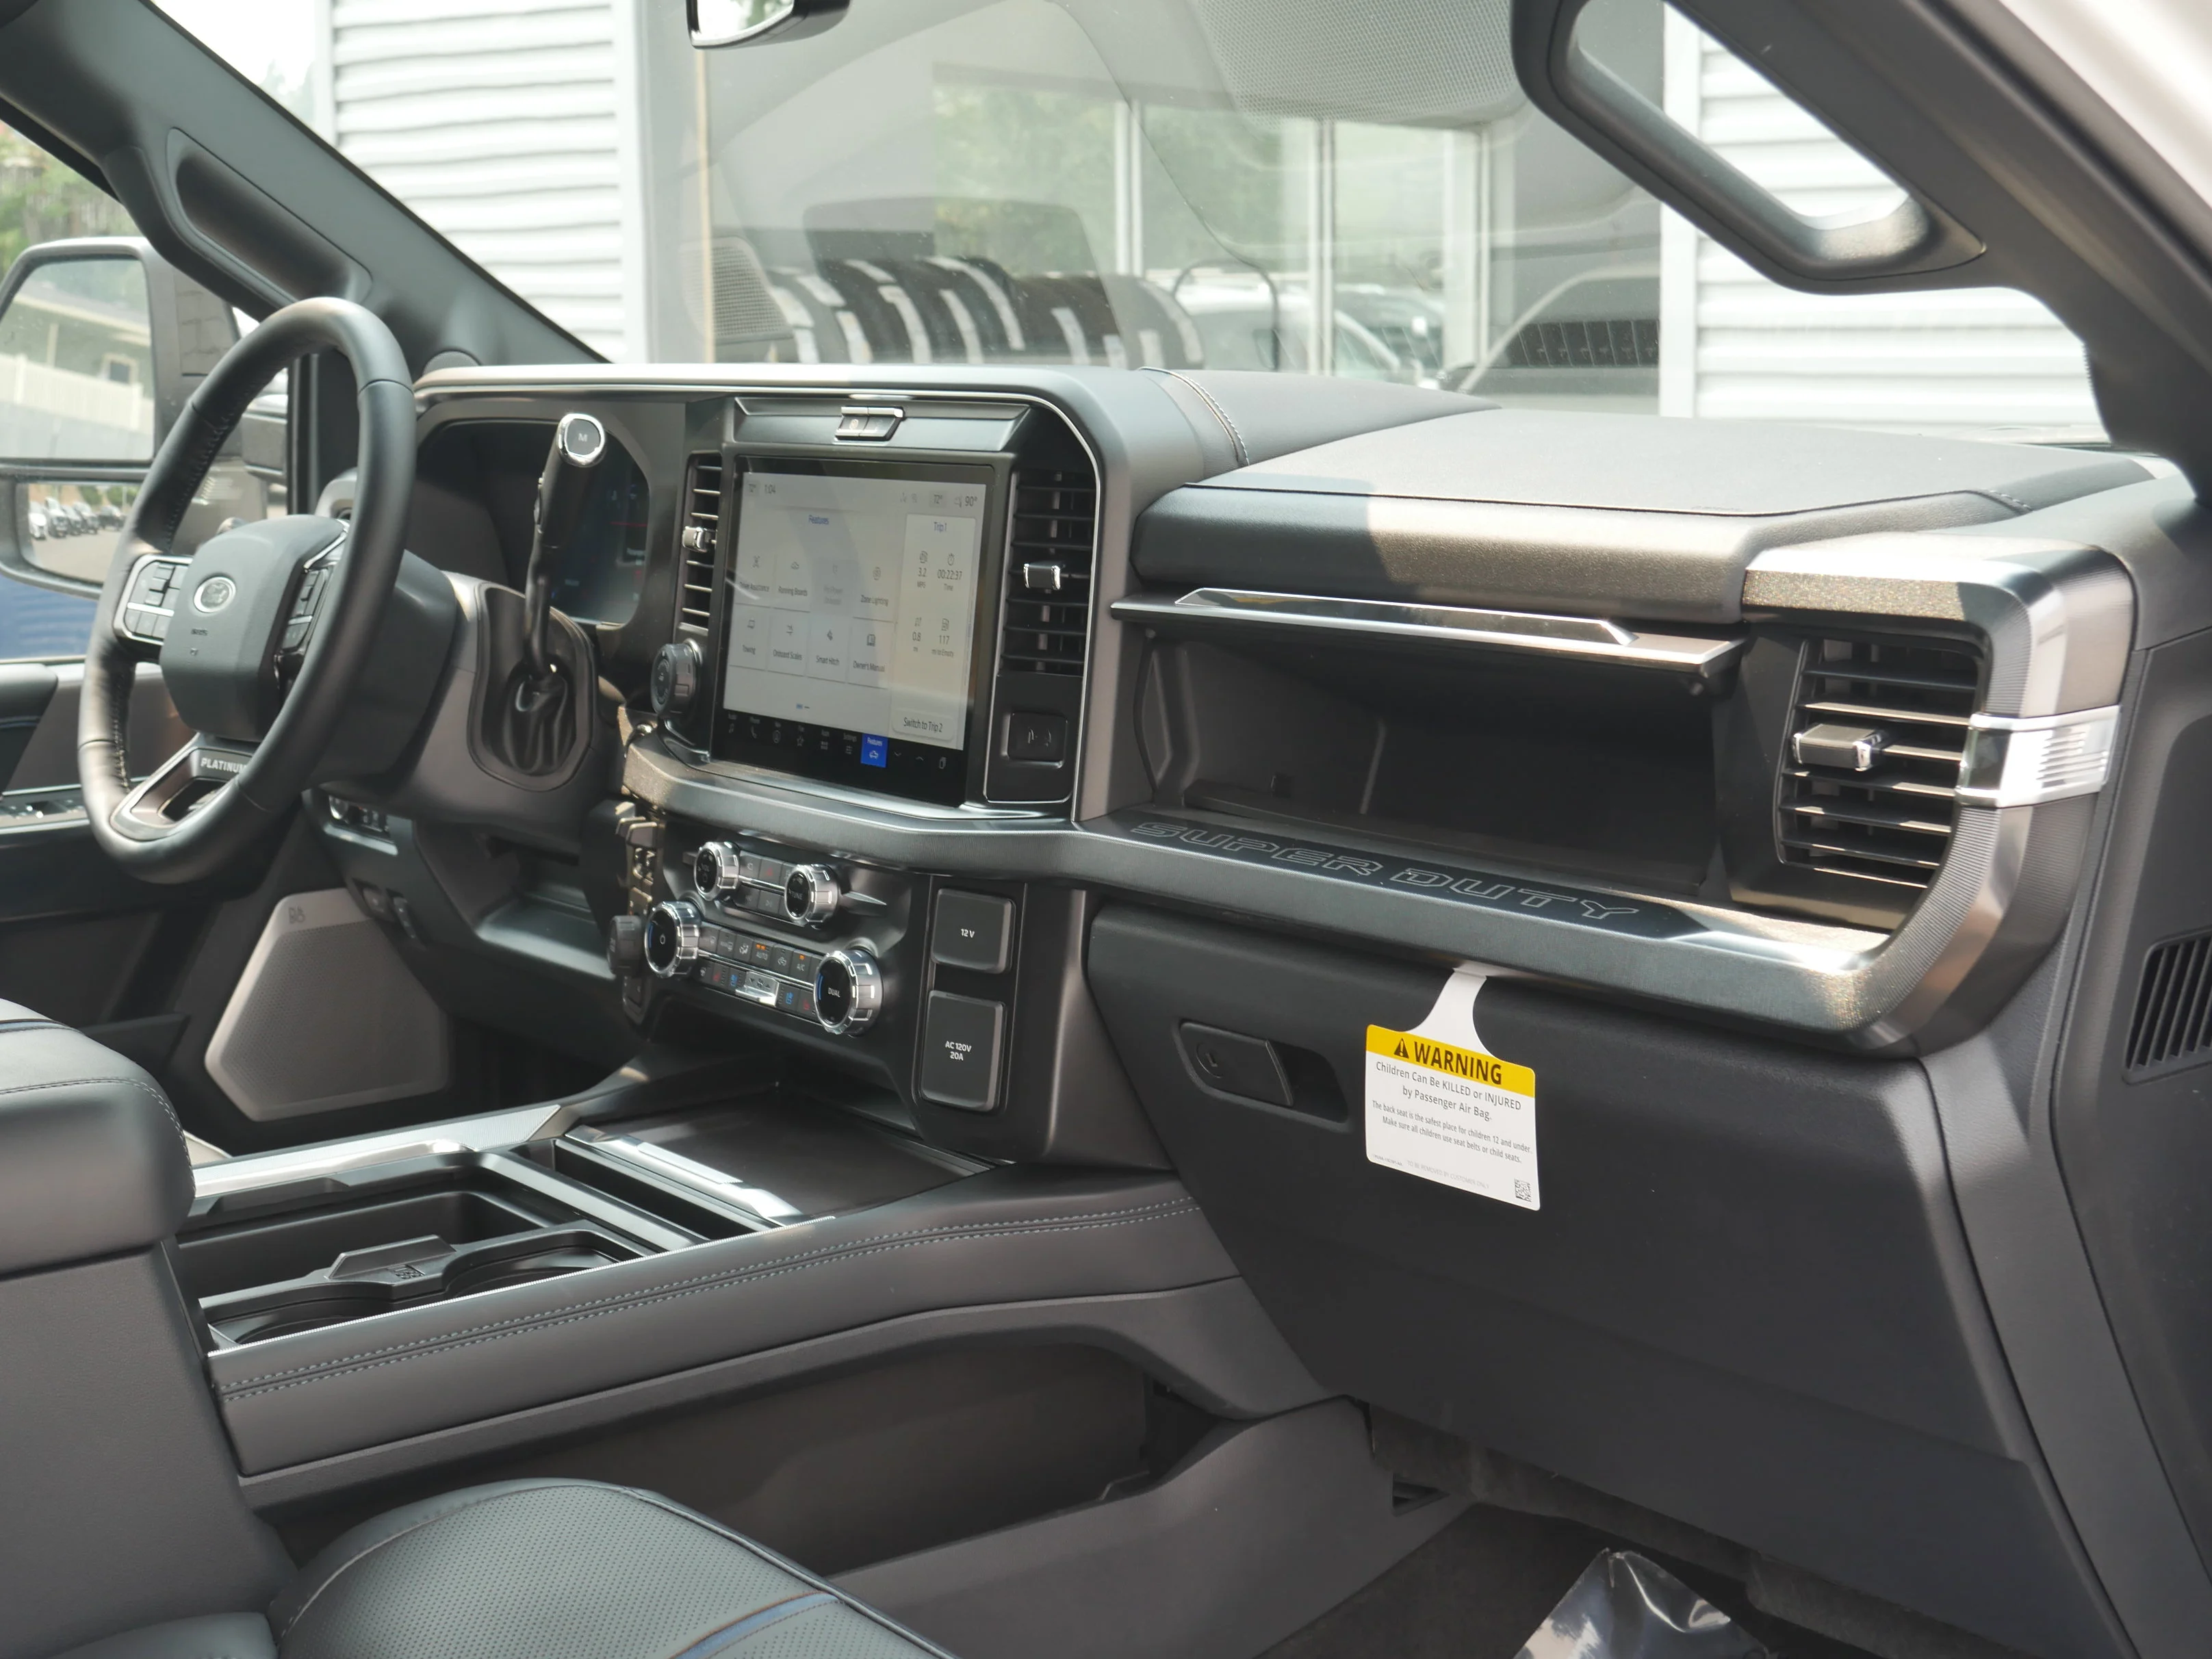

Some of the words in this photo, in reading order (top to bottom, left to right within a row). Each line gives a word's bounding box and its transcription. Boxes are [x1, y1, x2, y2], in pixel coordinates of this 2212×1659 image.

[578, 433, 588, 442] M
[964, 496, 978, 506] 90°
[903, 717, 921, 730] Switch
[921, 722, 927, 730] to
[929, 722, 939, 734] Trip
[1129, 821, 1384, 877] SUPER
[1389, 868, 1640, 920] DUTY
[961, 928, 969, 937] 12
[828, 987, 841, 999] DUAL
[945, 1040, 955, 1049] AC
[955, 1042, 972, 1053] 120V
[950, 1051, 964, 1061] 20A
[1414, 1040, 1502, 1085] WARNING
[1376, 1061, 1410, 1079] Children
[1412, 1071, 1428, 1085] Can
[1430, 1076, 1441, 1088] Be
[1442, 1080, 1471, 1096] KILLED
[1473, 1091, 1482, 1100] or
[1484, 1092, 1521, 1111] INJURED
[1402, 1085, 1413, 1099] by
[1415, 1089, 1456, 1110] Passenger
[1459, 1102, 1471, 1114] Air
[1474, 1106, 1492, 1122] Bag.
[1372, 1100, 1382, 1110] The
[1382, 1103, 1396, 1114] back
[1397, 1109, 1408, 1118] seat
[1409, 1111, 1414, 1120] is
[1415, 1113, 1424, 1123] the
[1425, 1116, 1441, 1129] safest
[1442, 1120, 1457, 1133] place
[1458, 1124, 1467, 1135] for
[1468, 1129, 1491, 1142] children
[1493, 1135, 1500, 1144] 12
[1501, 1138, 1512, 1148] and
[1382, 1115, 1398, 1128] Make
[1398, 1121, 1411, 1131] sure
[1419, 1127, 1441, 1141] children
[1443, 1134, 1452, 1144] use
[1454, 1137, 1465, 1148] seat
[1467, 1140, 1481, 1152] belts
[1482, 1146, 1488, 1154] or
[1489, 1146, 1504, 1158] child
[1504, 1152, 1523, 1164] seats.
